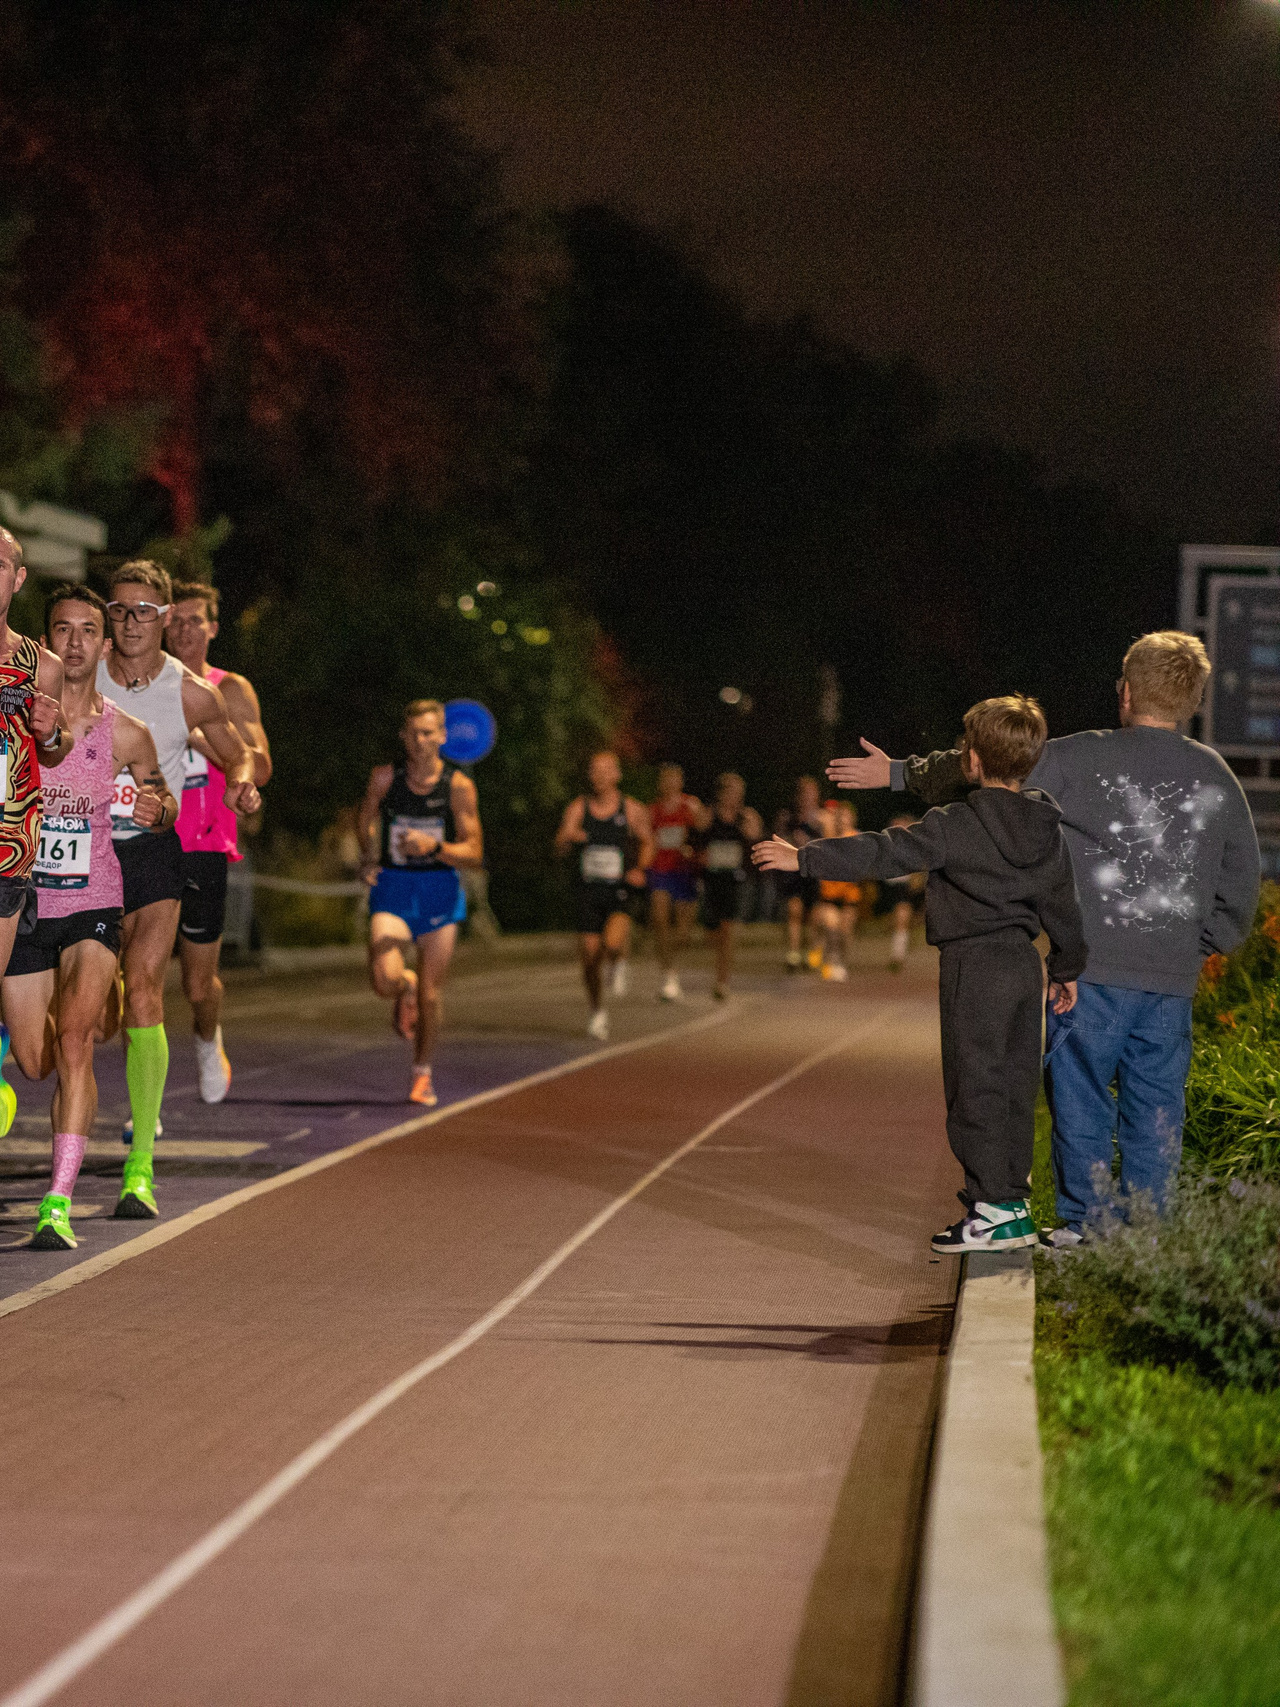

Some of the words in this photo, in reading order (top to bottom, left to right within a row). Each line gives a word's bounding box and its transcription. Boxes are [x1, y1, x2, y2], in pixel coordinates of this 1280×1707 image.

[41, 784, 71, 806] agic
[60, 796, 95, 817] pills
[39, 836, 78, 861] 161
